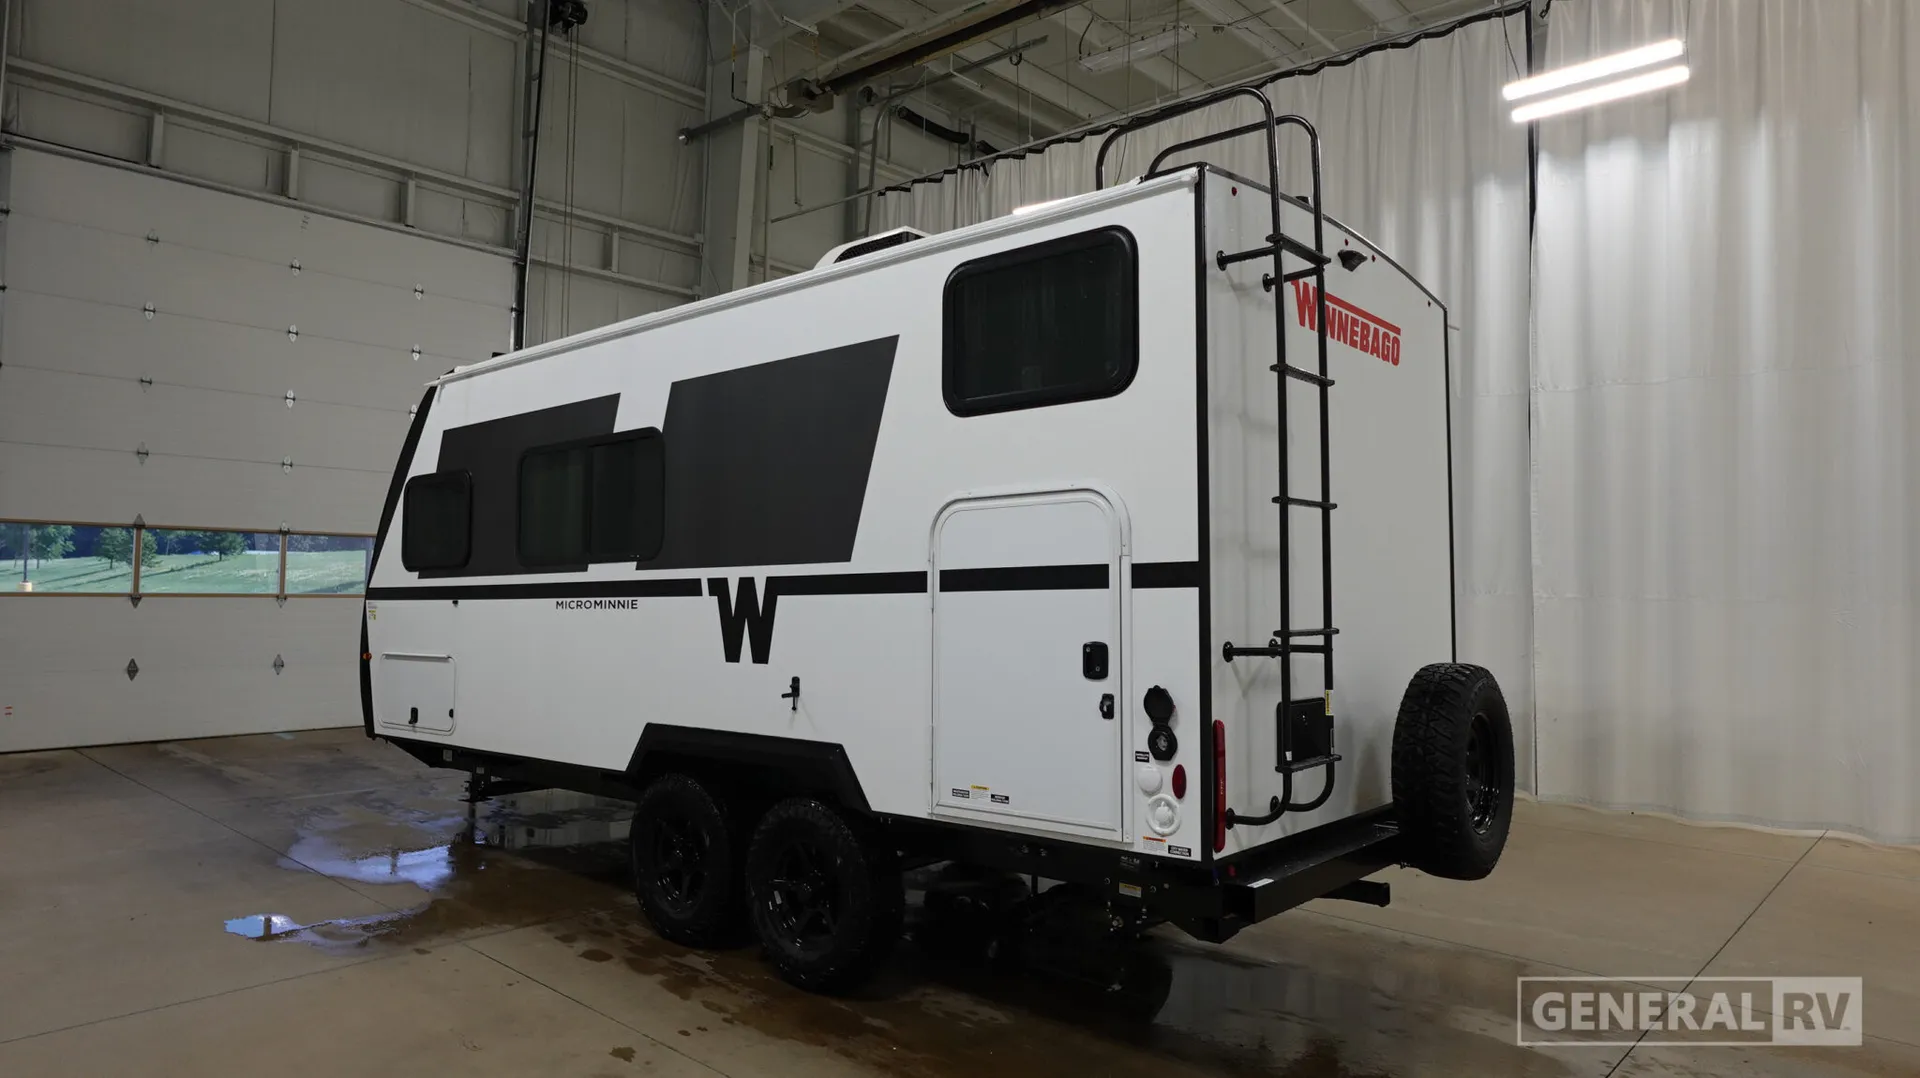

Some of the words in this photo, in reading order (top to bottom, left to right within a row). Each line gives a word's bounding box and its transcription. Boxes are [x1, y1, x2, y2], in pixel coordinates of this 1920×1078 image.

[1291, 280, 1401, 367] WNNEBAGO
[555, 599, 639, 610] MICROMINNIE
[707, 576, 779, 665] W
